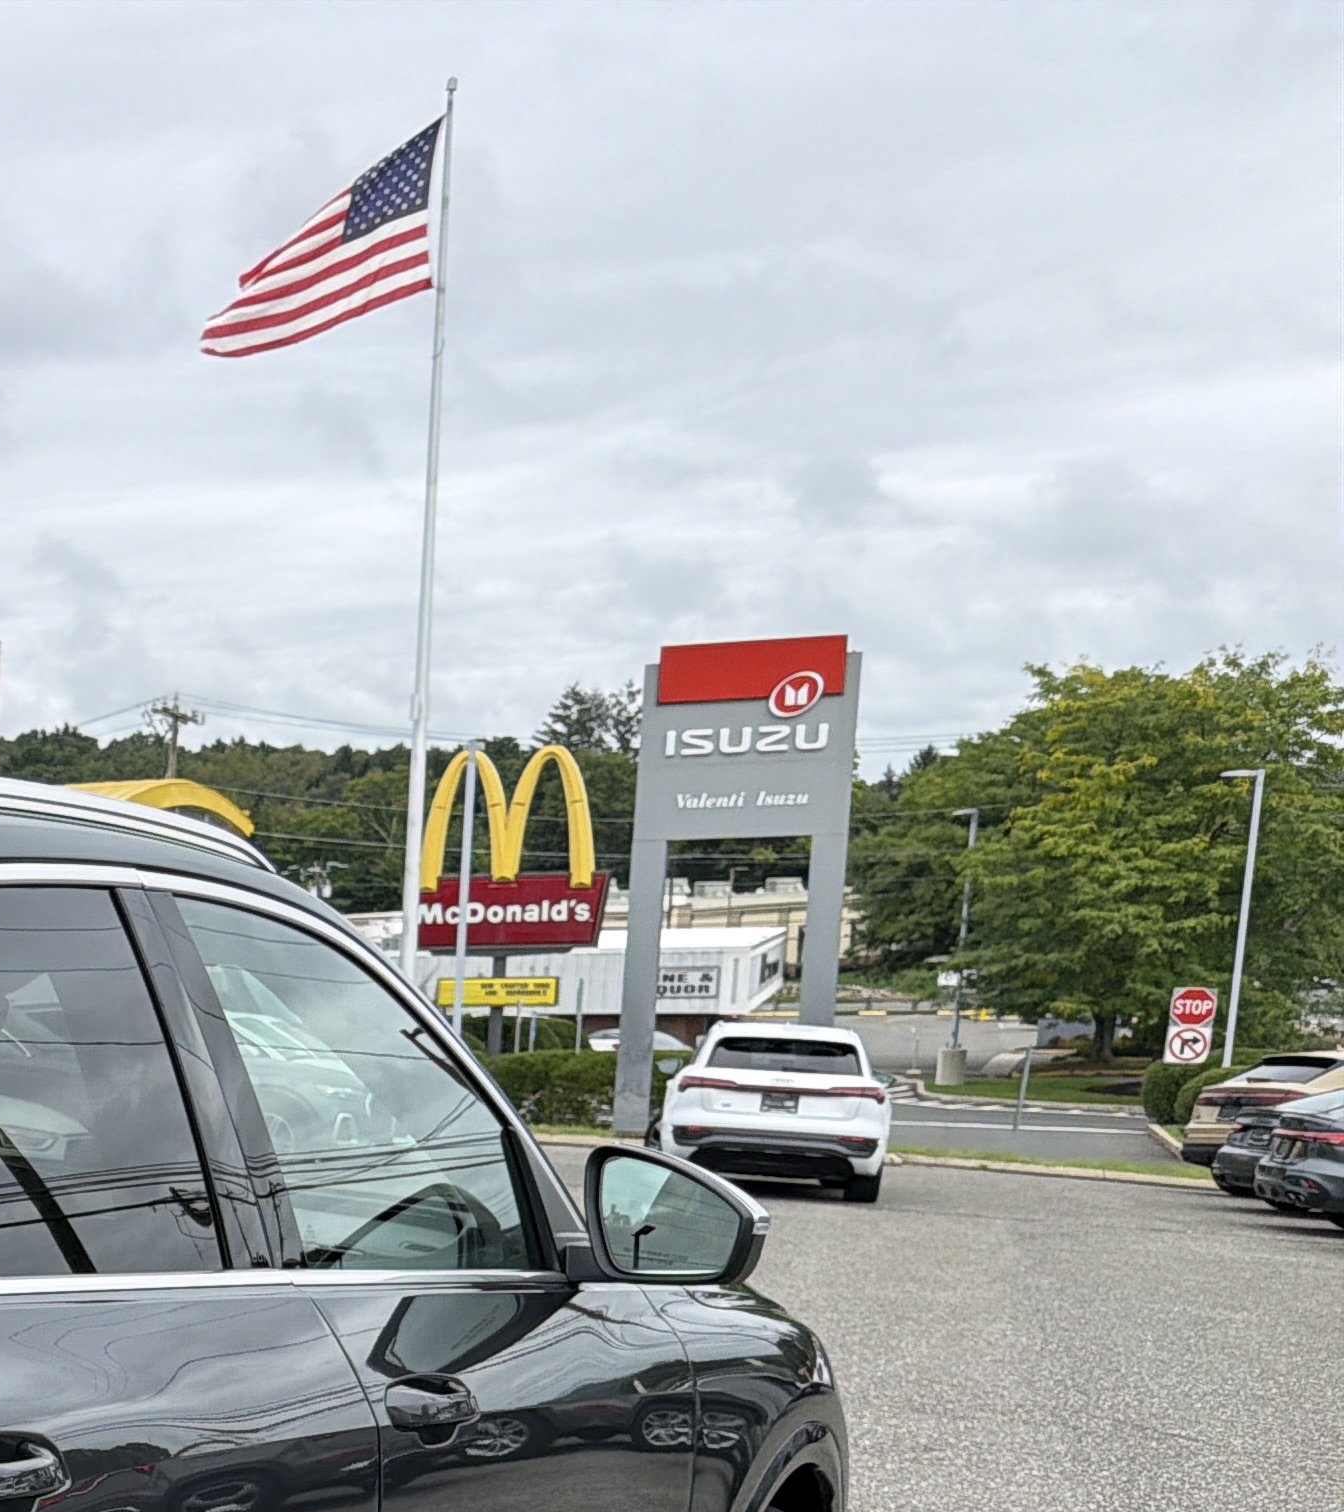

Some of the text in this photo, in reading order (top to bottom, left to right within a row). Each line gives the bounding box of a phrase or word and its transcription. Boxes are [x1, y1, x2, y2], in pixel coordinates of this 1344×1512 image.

[665, 722, 830, 757] ISUZU
[676, 790, 809, 809] Valenti Isuzu
[417, 899, 591, 925] McDonald's
[662, 973, 688, 983] NE
[656, 984, 710, 996] QUOR
[1173, 999, 1213, 1015] STOP
